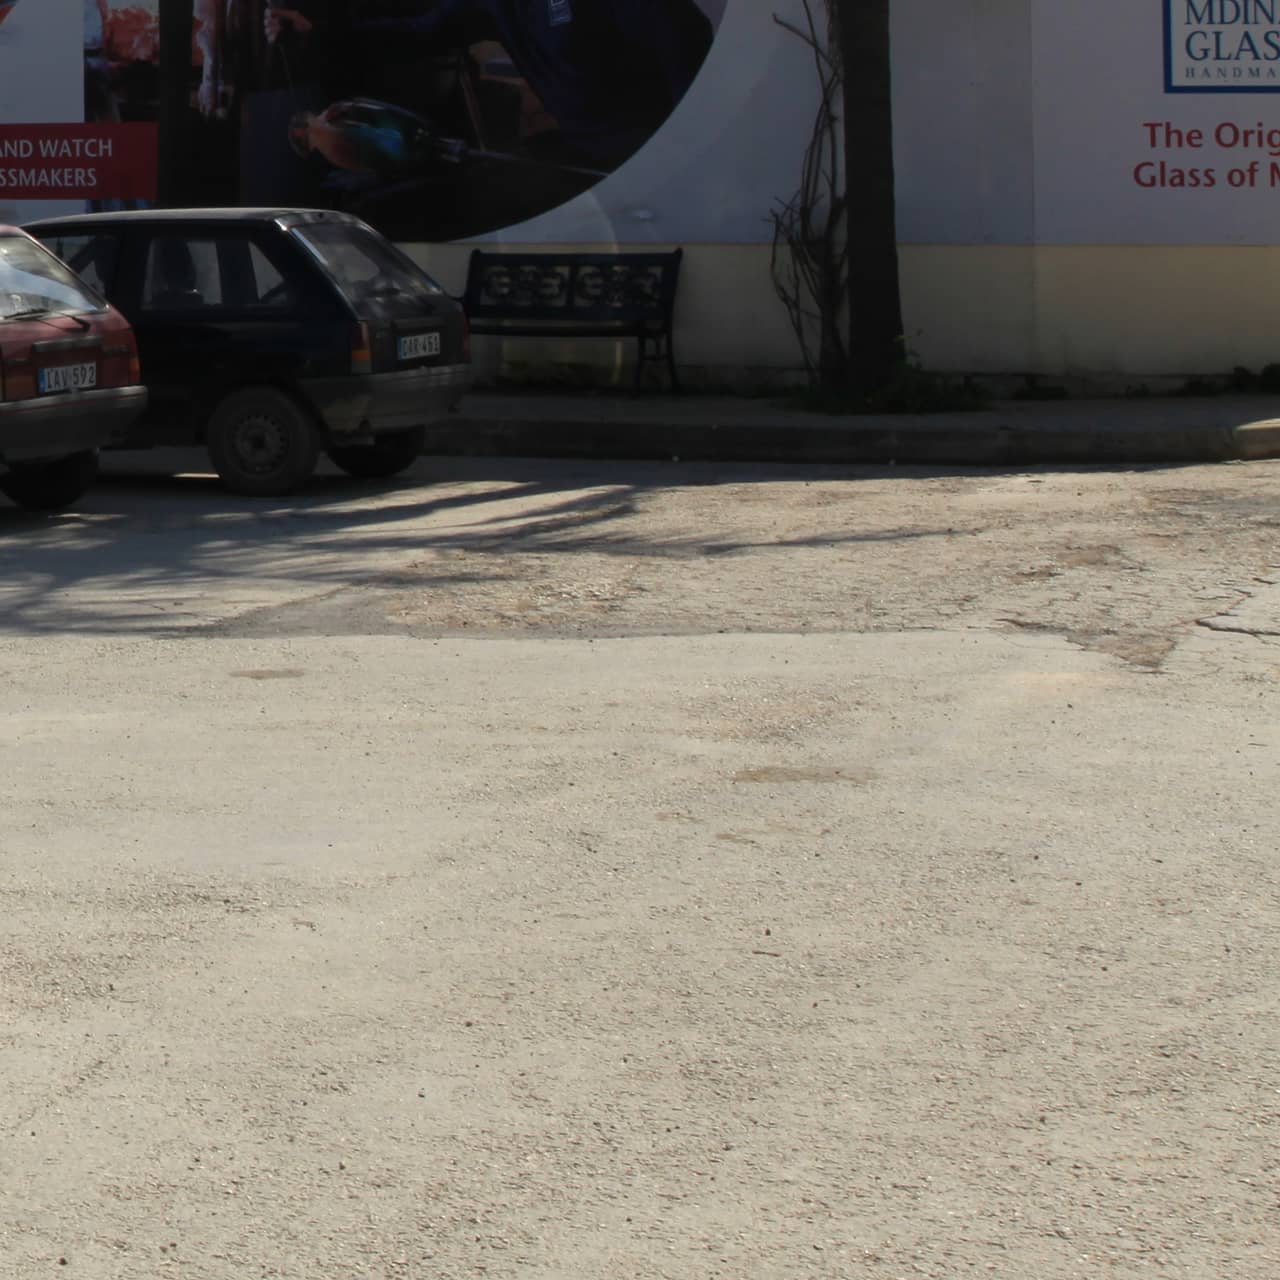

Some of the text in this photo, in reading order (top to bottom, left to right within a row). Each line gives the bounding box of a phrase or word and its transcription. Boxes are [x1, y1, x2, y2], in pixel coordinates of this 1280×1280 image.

[39, 138, 113, 158] WATCH
[1143, 122, 1203, 148] The
[1133, 161, 1216, 188] Glass
[1227, 161, 1259, 188] of
